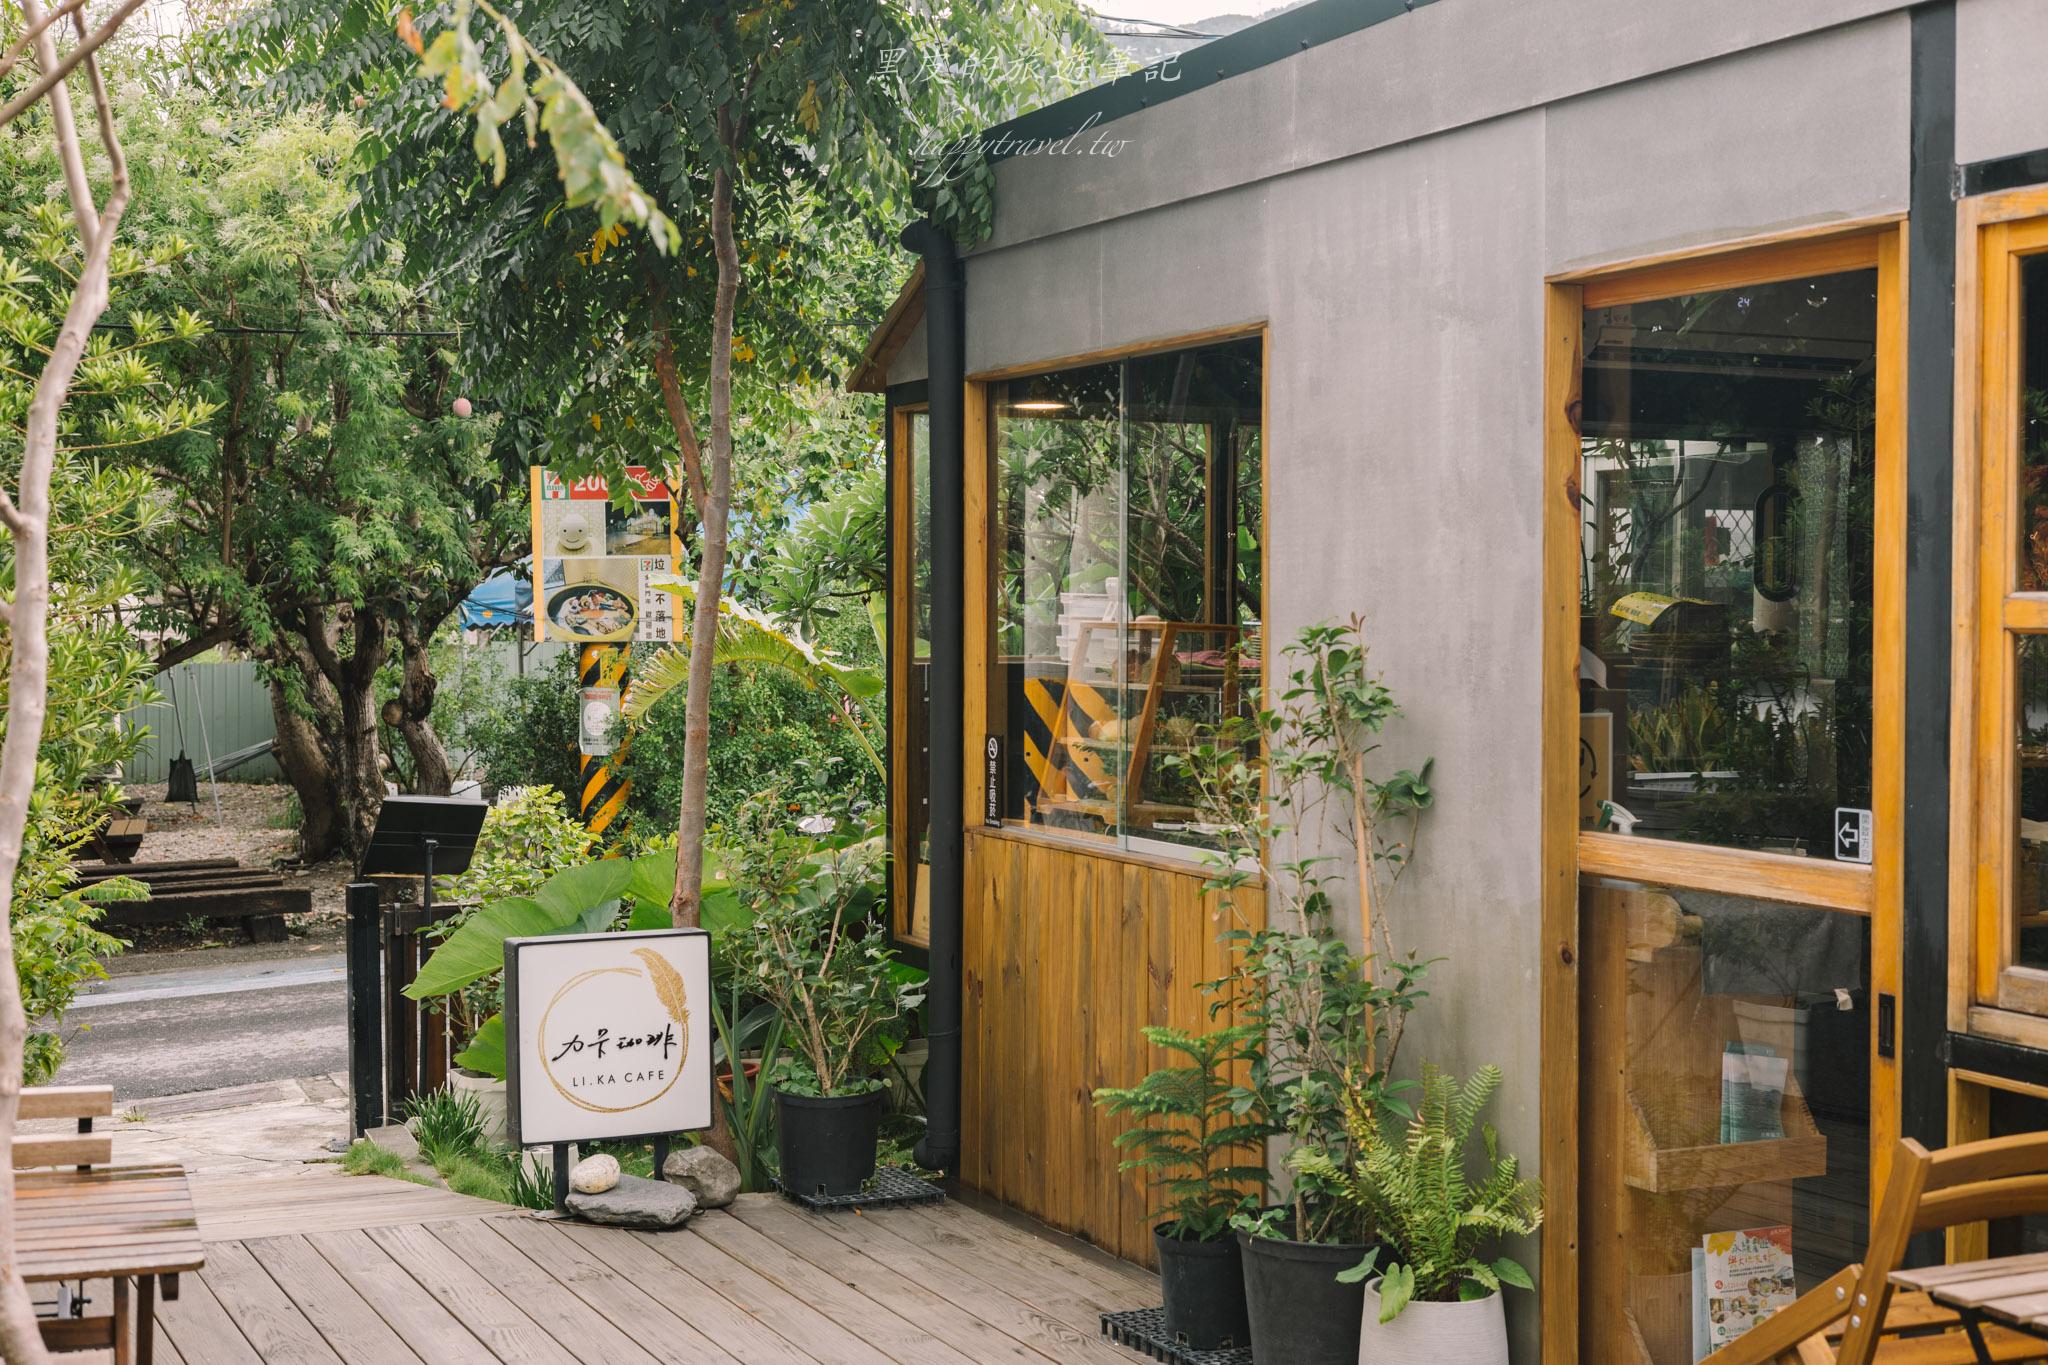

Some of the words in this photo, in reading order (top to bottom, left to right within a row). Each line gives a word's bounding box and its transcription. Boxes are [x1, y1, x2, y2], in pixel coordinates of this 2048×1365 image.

[655, 558, 666, 639] 垃不落地
[573, 1074, 616, 1087] LI.KA
[624, 1070, 665, 1083] CAFE
